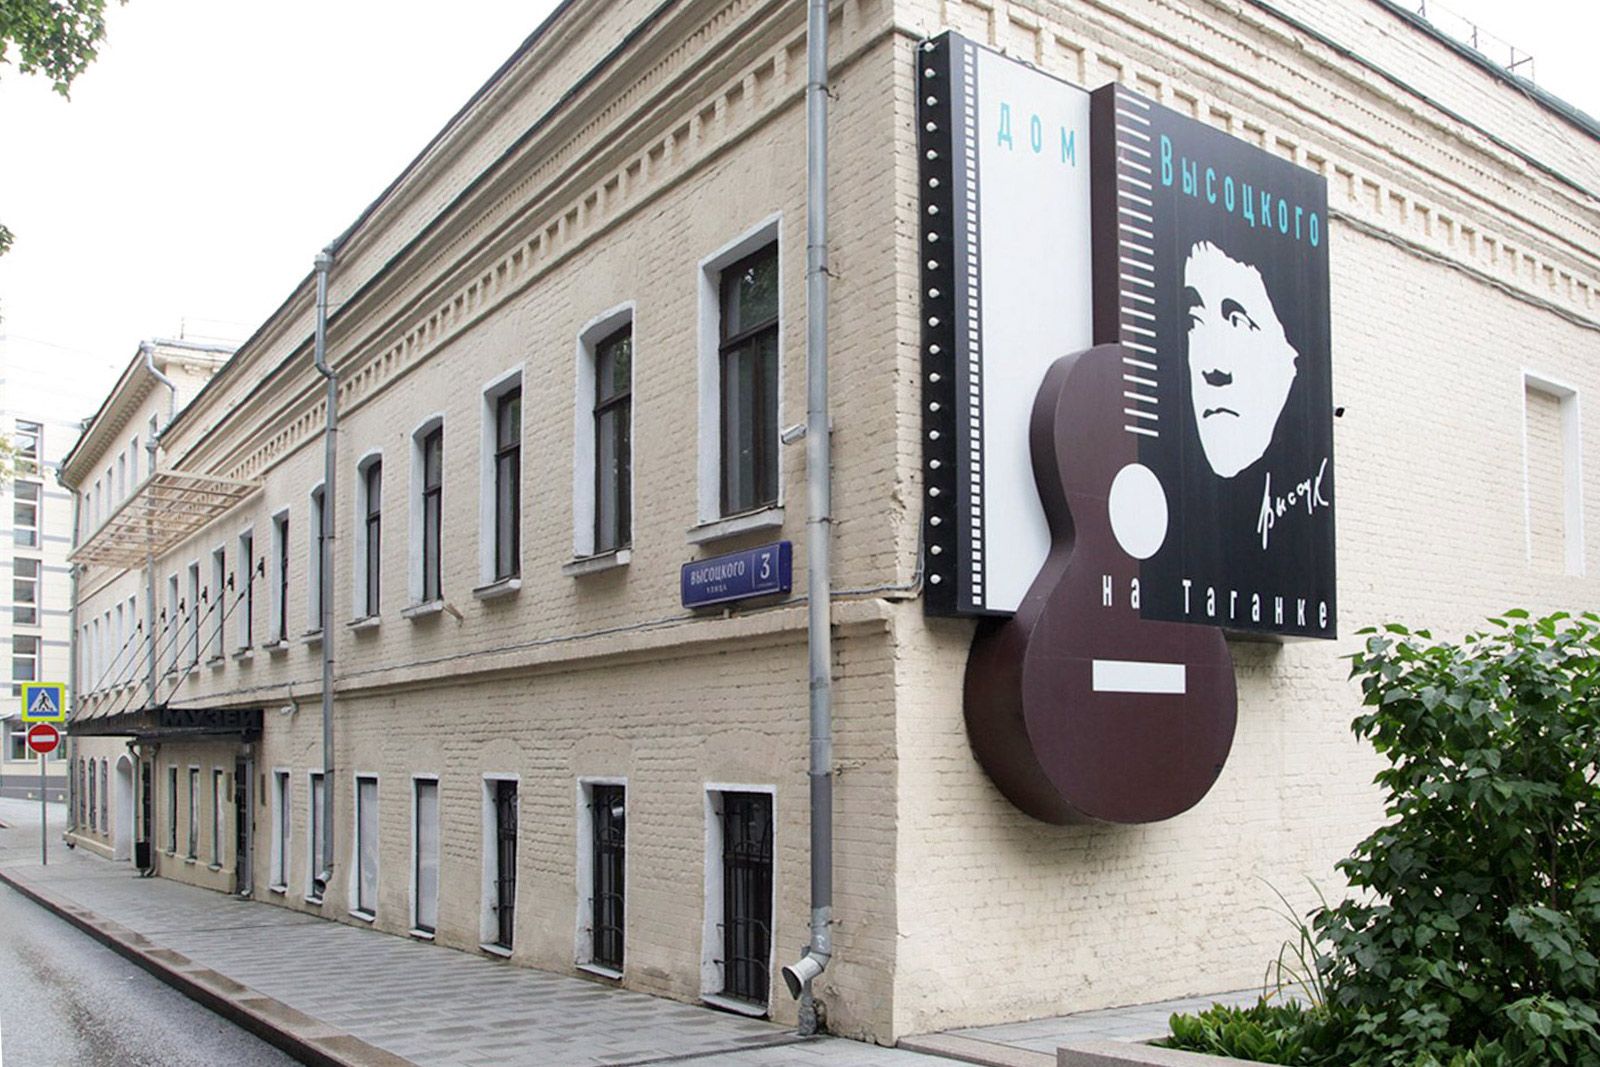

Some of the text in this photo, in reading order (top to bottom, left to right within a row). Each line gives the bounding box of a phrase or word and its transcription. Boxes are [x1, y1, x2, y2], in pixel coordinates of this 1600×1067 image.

[1160, 134, 1320, 248] Высоцкого
[690, 552, 771, 585] ВЫСОЦКОГО 3
[1102, 575, 1327, 629] на Таганке
